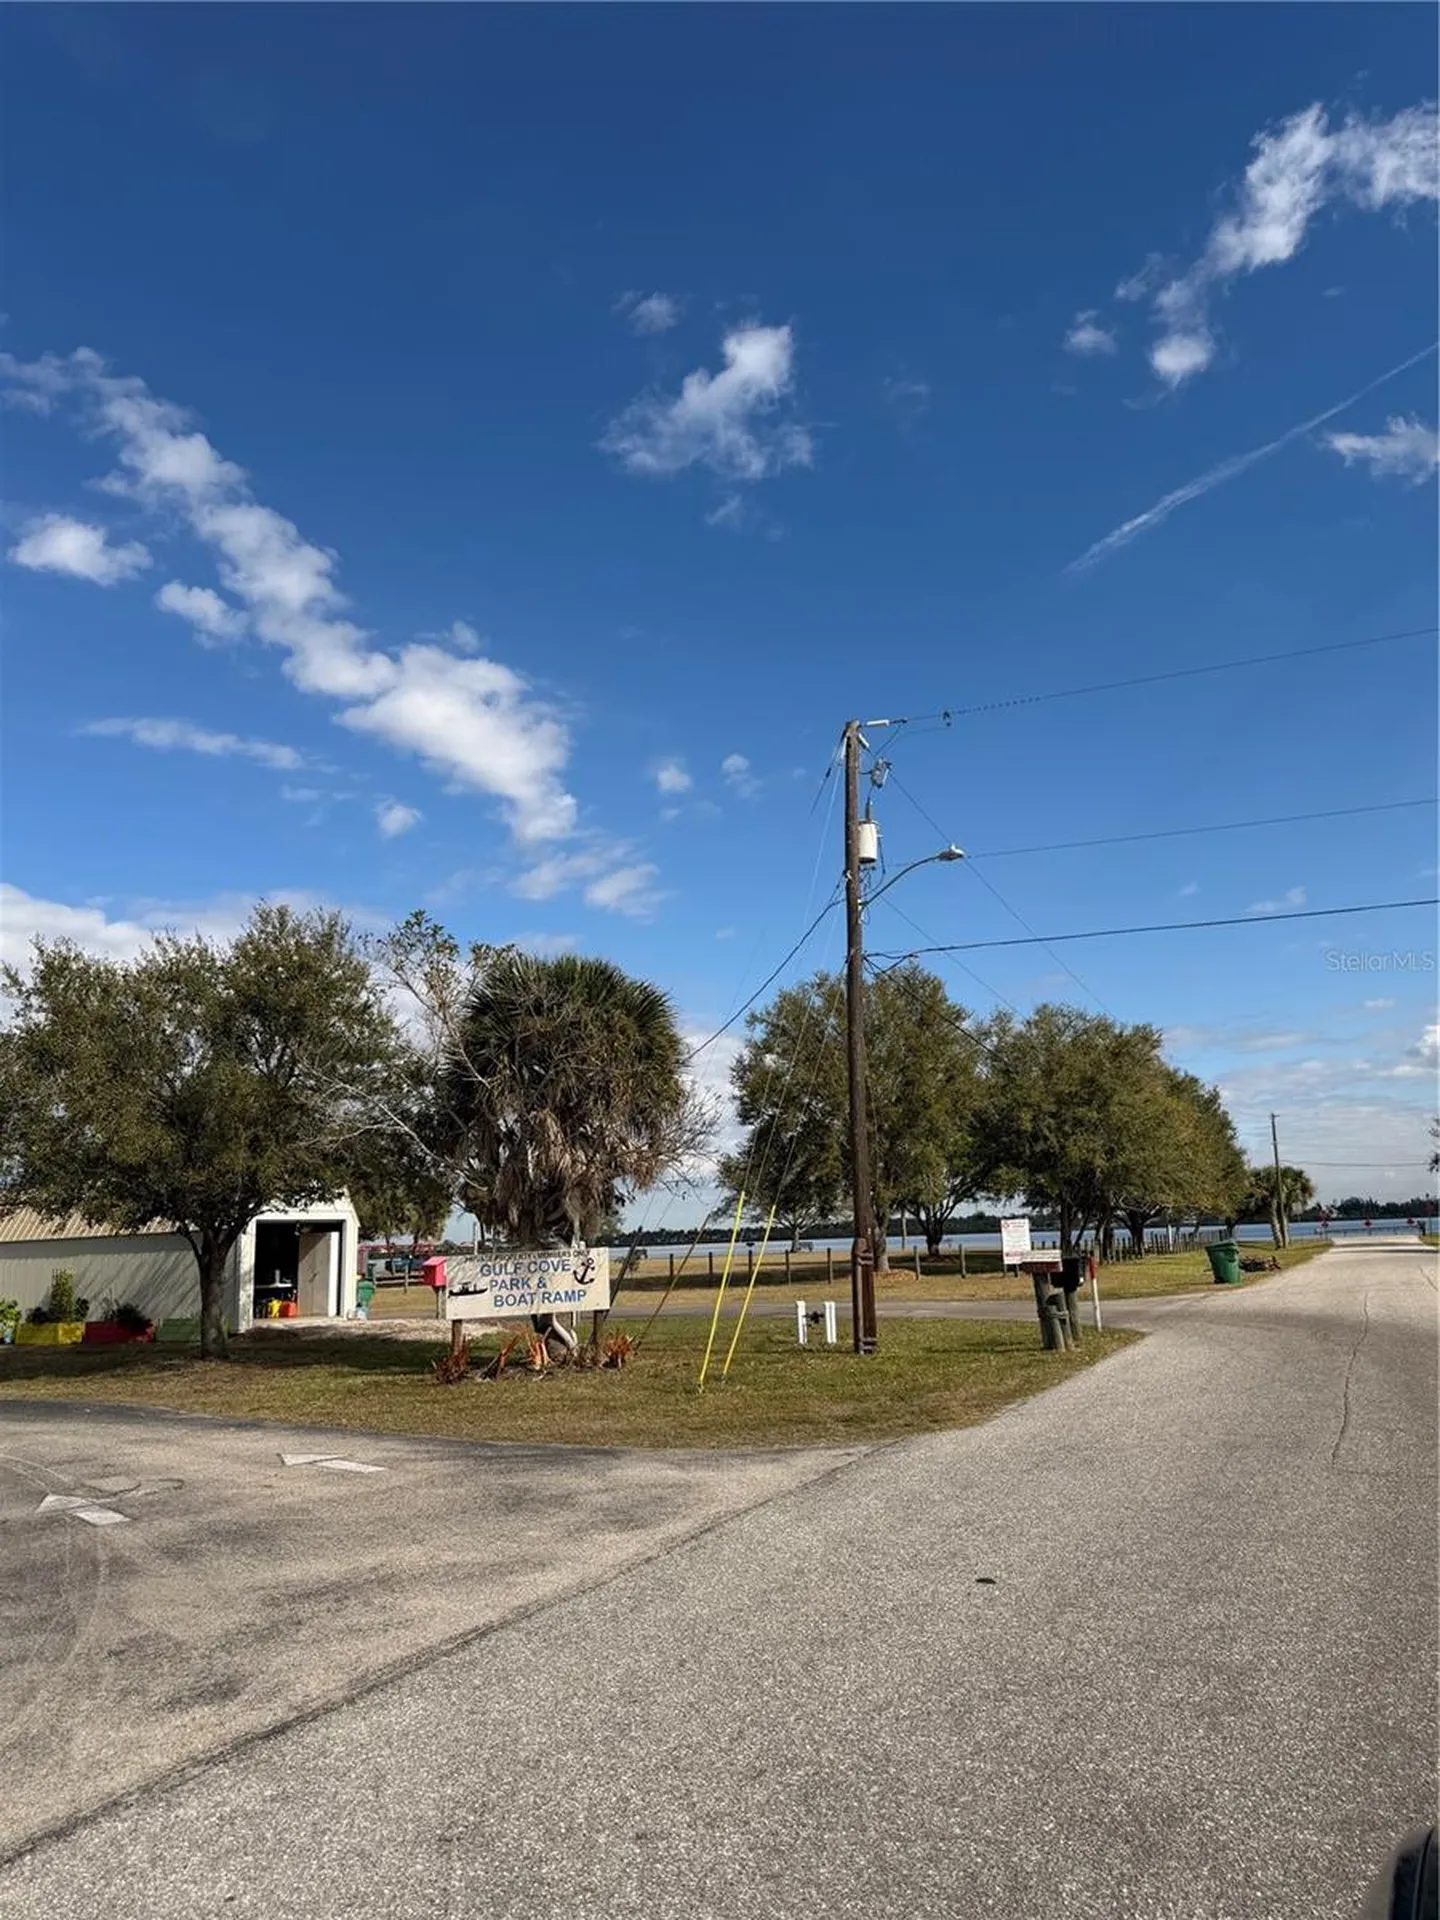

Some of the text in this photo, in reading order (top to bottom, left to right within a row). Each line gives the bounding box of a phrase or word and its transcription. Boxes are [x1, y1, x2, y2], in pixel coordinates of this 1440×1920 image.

[480, 1260, 572, 1277] GULF COVE
[490, 1277, 547, 1292] PARK &
[494, 1290, 587, 1307] BOAT RAMP
